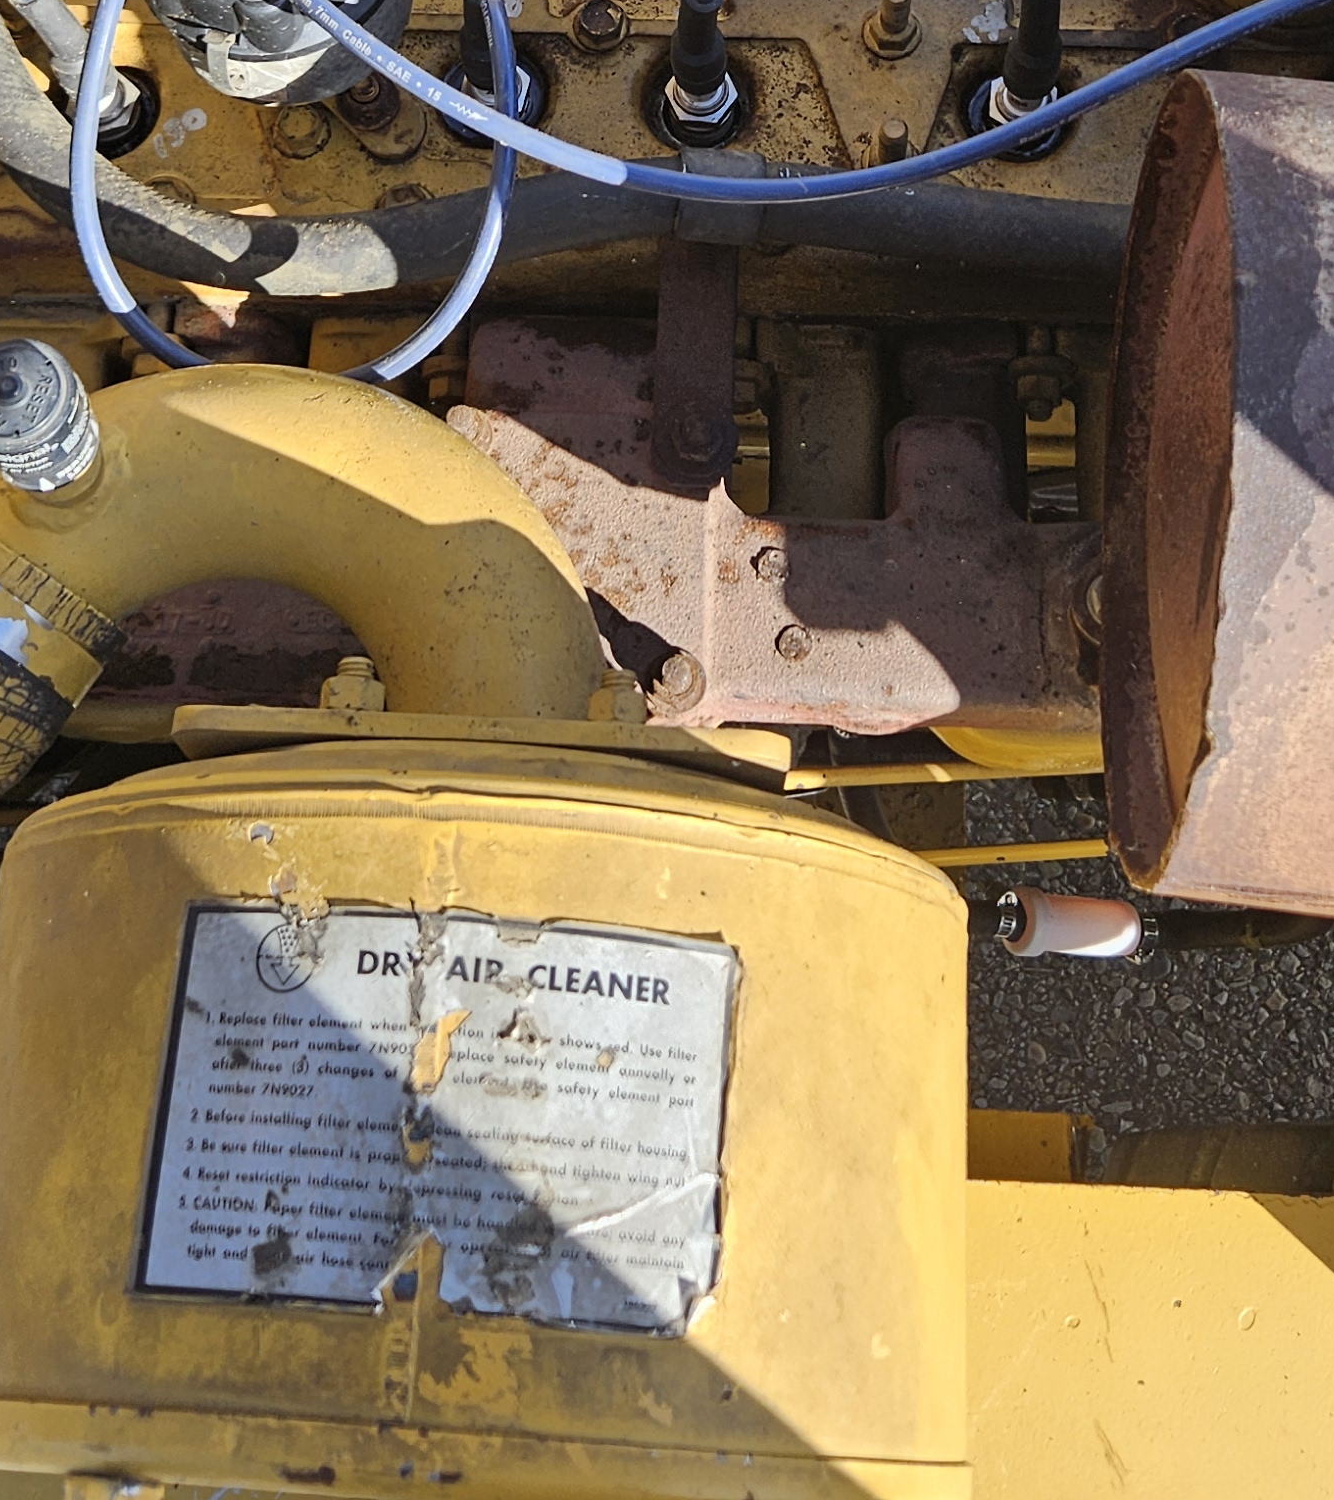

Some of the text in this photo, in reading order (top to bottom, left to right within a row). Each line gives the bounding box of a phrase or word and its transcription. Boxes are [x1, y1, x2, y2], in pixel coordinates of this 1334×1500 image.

[314, 4, 341, 32] 7mm
[340, 28, 374, 58] Cable
[384, 60, 412, 84] SAE
[425, 86, 442, 103] 15
[527, 964, 670, 1006] CLEANER
[215, 1034, 264, 1047] element
[272, 1039, 299, 1051] part
[308, 1042, 361, 1052] number
[449, 1048, 494, 1063] eplace
[504, 1052, 546, 1069] safety
[619, 1064, 675, 1085] annually
[683, 1075, 695, 1085] or
[219, 1012, 266, 1026] Replace
[272, 1012, 304, 1026] filter
[309, 1014, 363, 1029] element
[560, 1034, 601, 1050] shows
[640, 1043, 662, 1058] Use
[668, 1046, 698, 1061] filter
[209, 1083, 256, 1094] number
[250, 1058, 282, 1072] three
[318, 1061, 374, 1078] changes
[385, 1066, 397, 1078] of
[557, 1082, 600, 1099] safety
[609, 1086, 660, 1103] element
[669, 1096, 694, 1108] part
[205, 1108, 246, 1123] Before
[251, 1110, 311, 1130] installing
[318, 1113, 352, 1128] filter
[357, 1117, 398, 1132] eleme
[432, 1122, 461, 1137] lean
[466, 1127, 519, 1144] sealing
[526, 1132, 574, 1147] surface
[581, 1136, 596, 1148] of
[600, 1136, 632, 1152] filter
[197, 1167, 230, 1180] Reset
[236, 1170, 301, 1185] restriction
[308, 1172, 370, 1189] indicator
[201, 1138, 216, 1151] Be
[221, 1142, 247, 1152] sure
[252, 1140, 283, 1154] filter
[290, 1143, 344, 1158] element
[350, 1149, 360, 1159] is
[573, 1164, 620, 1180] tighten
[627, 1172, 658, 1187] wing
[190, 1219, 242, 1238] damage
[248, 1225, 260, 1236] to
[626, 1254, 684, 1269] maintain
[309, 1202, 343, 1216] filter
[453, 1213, 470, 1227] be
[619, 1230, 655, 1242] avoid
[662, 1235, 686, 1248] any
[187, 1244, 216, 1261] tight
[223, 1247, 248, 1258] and
[322, 1250, 353, 1267] hose
